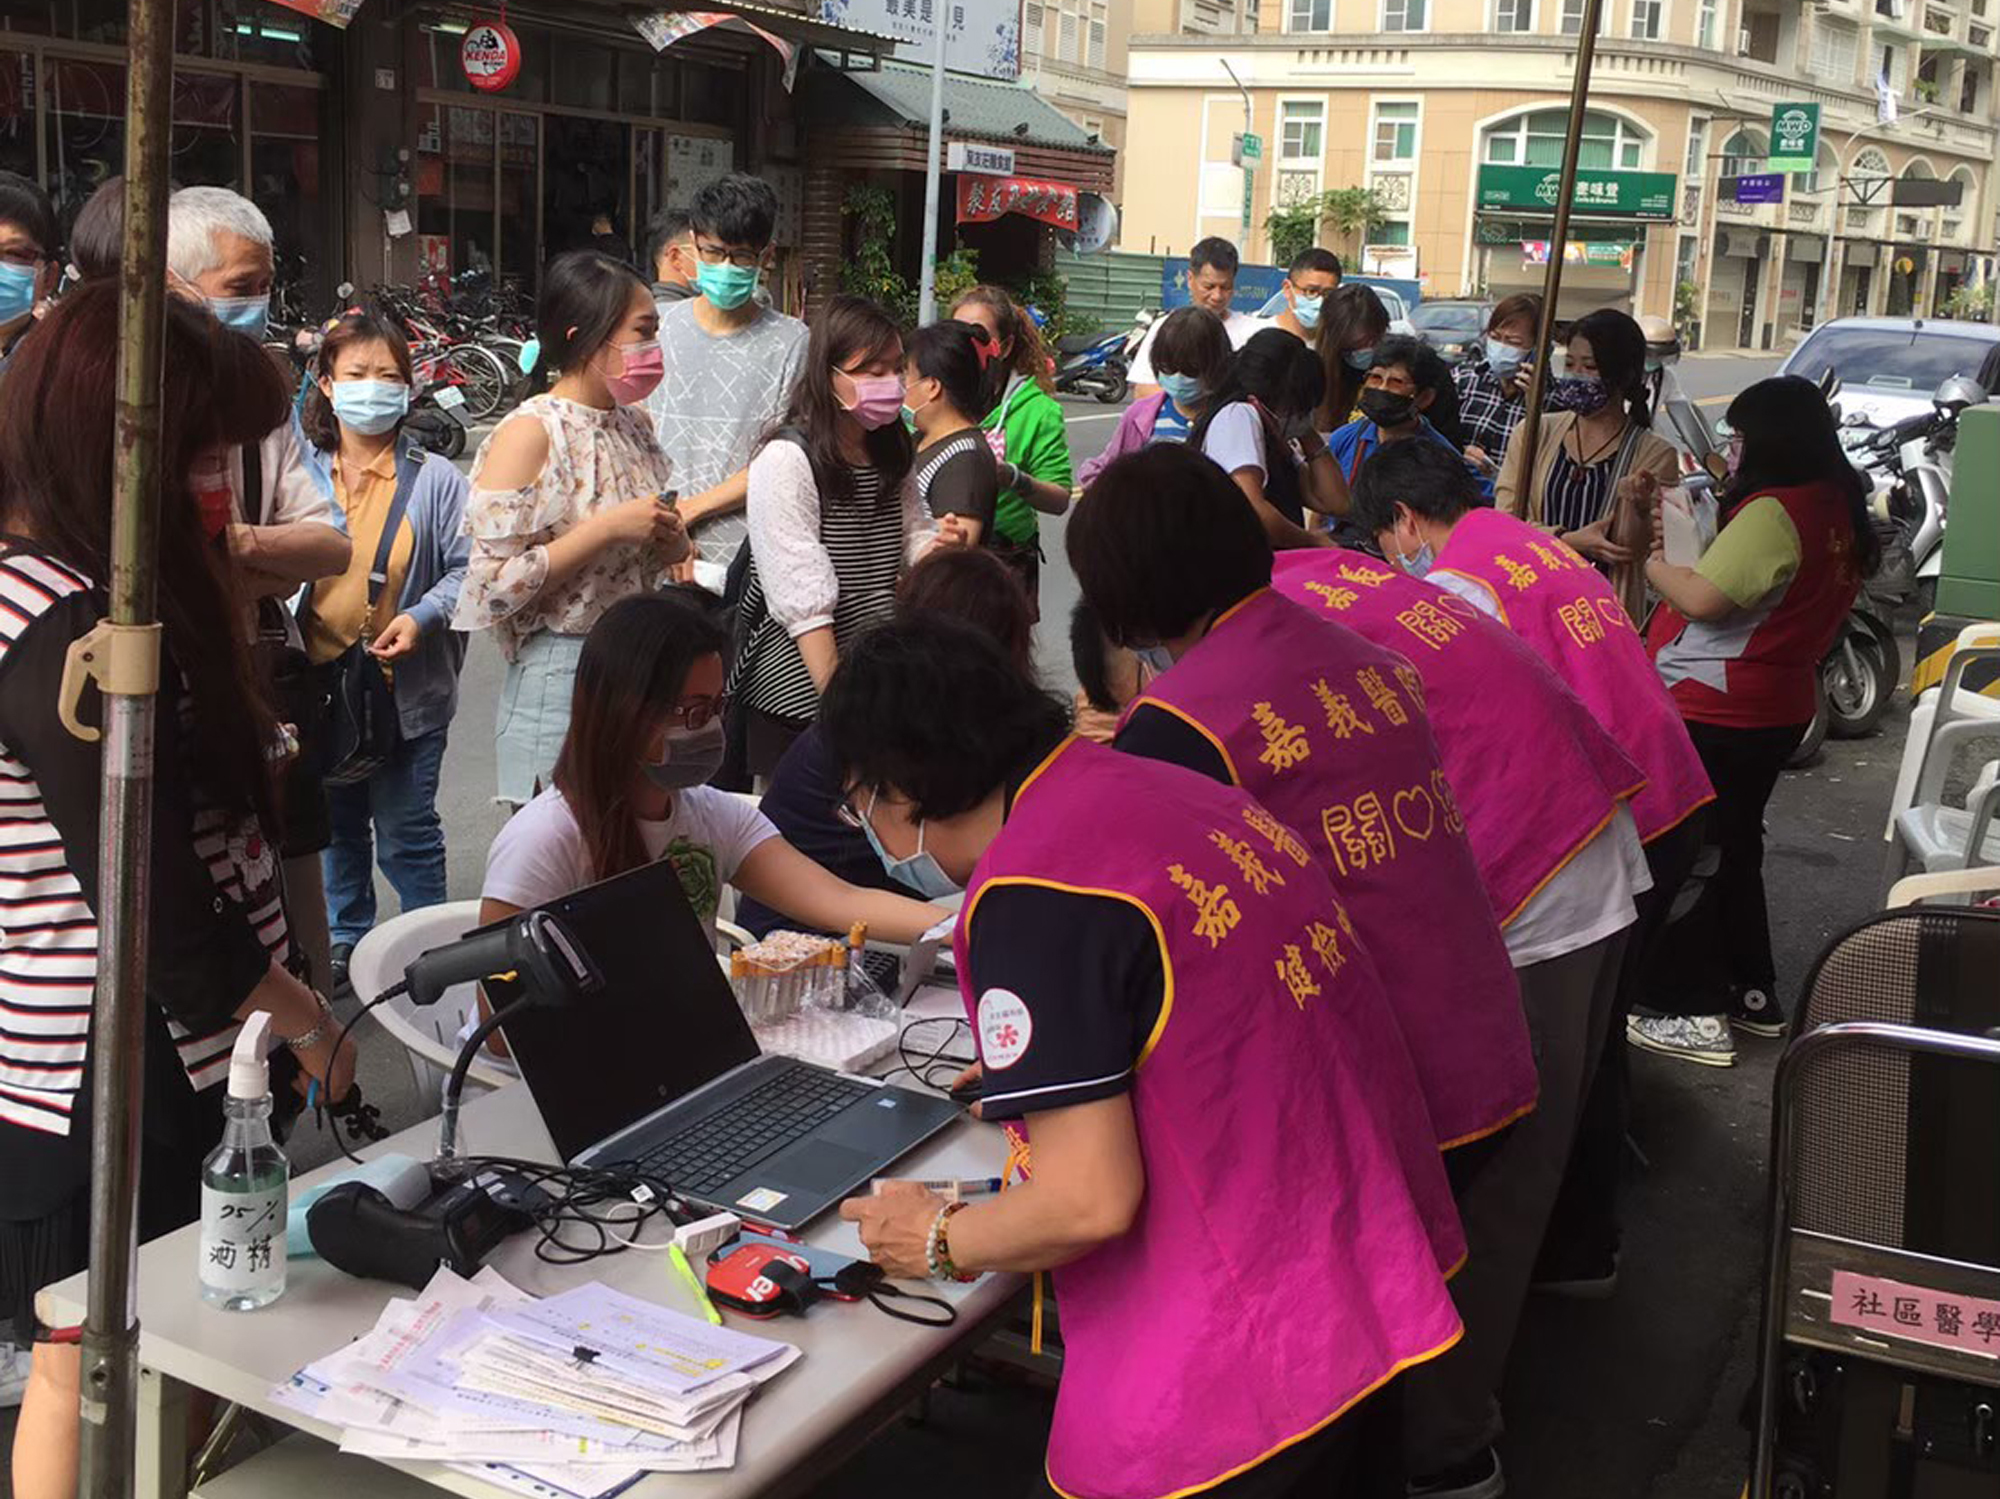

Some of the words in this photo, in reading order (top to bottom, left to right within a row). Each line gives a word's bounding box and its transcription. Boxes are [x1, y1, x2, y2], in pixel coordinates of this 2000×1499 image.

[885, 0, 965, 31] 最美是見
[466, 51, 506, 61] KENDA
[1775, 119, 1813, 133] MWD
[1851, 1288, 2000, 1344] 社區醫學
